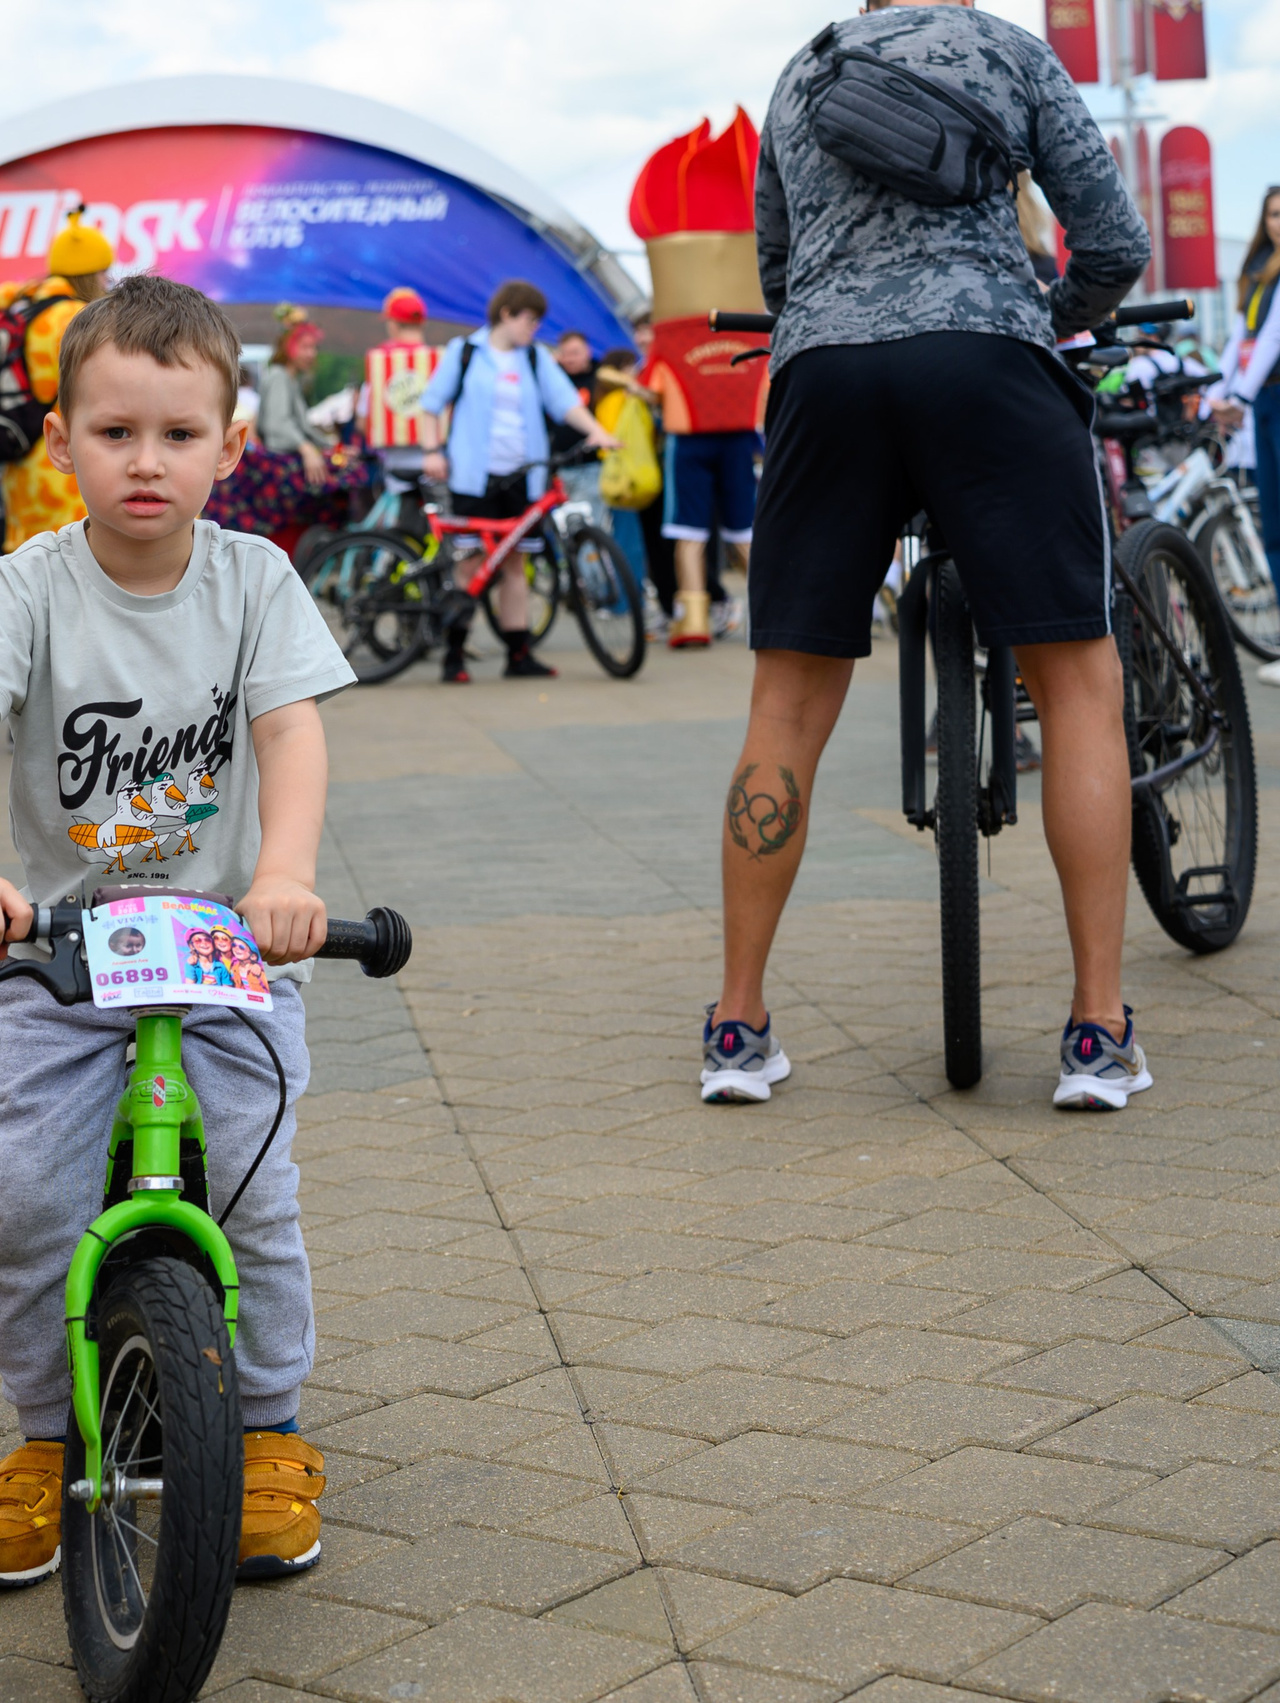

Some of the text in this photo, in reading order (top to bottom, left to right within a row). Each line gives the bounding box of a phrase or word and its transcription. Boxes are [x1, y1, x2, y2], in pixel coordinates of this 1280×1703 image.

[228, 223, 305, 250] КЛУБ
[117, 915, 144, 924] VIVA
[96, 967, 168, 986] 06899
